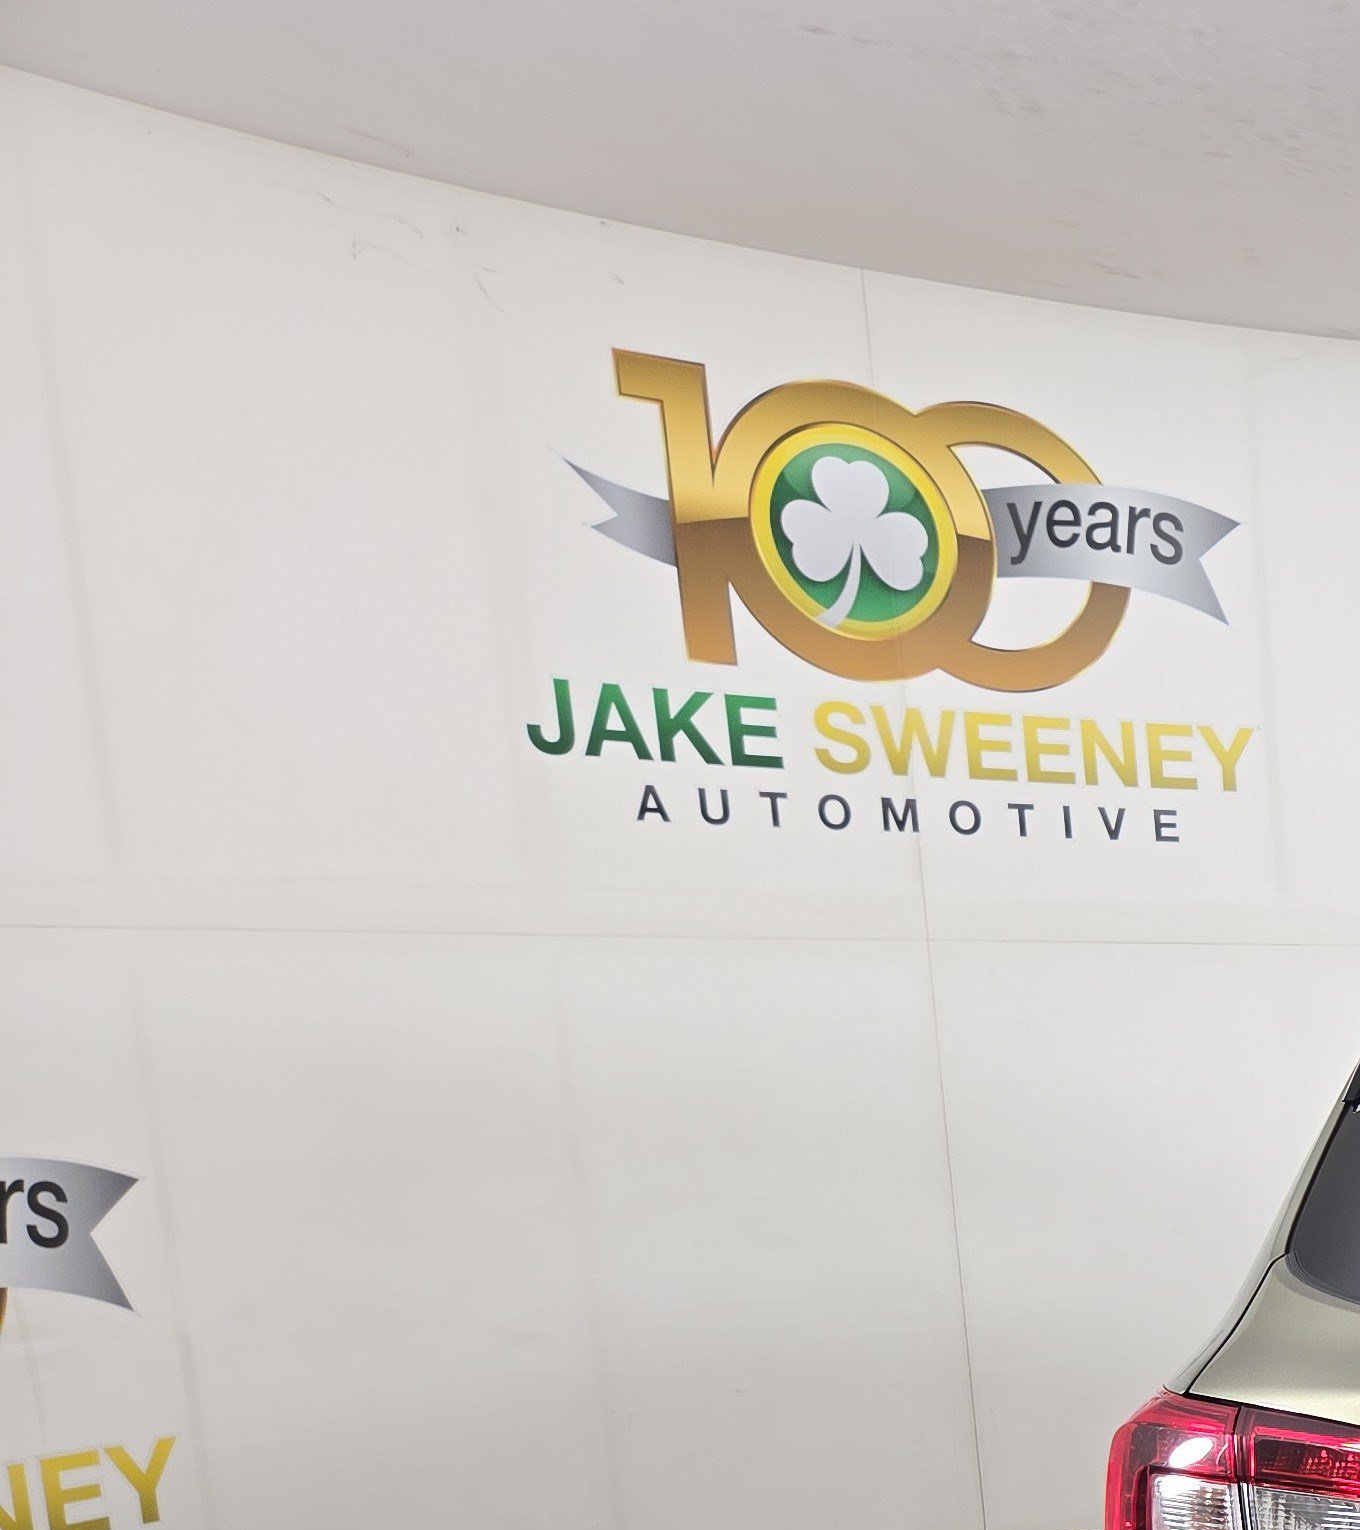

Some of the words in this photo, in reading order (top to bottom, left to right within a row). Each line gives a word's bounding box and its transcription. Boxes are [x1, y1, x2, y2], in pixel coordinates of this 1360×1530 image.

[612, 347, 1133, 693] 100
[1006, 498, 1185, 566] years
[526, 678, 785, 770] JAKE
[812, 700, 1255, 792] SWEENEY
[636, 784, 1181, 842] AUTOMOTIVE
